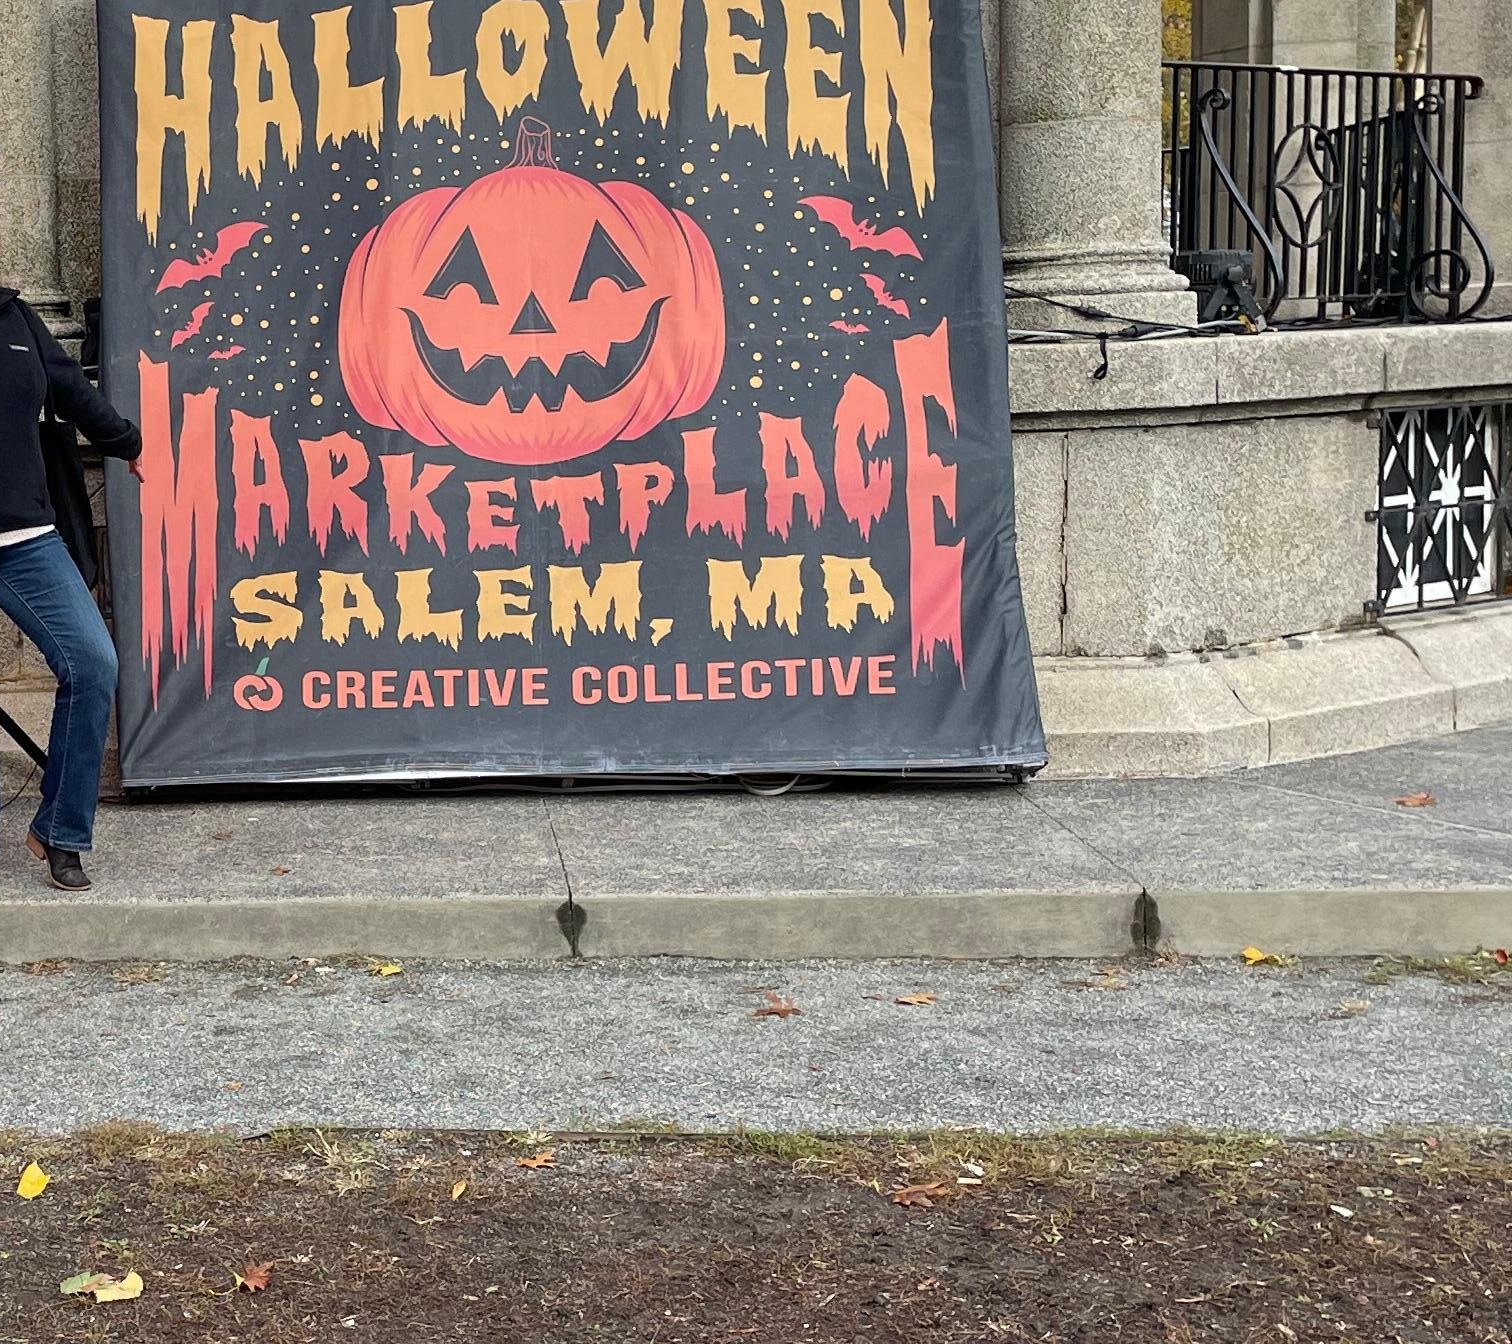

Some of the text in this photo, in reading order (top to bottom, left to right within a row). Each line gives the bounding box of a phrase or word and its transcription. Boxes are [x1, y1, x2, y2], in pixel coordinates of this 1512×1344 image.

[136, 318, 966, 711] MARKETPLACE
[231, 555, 894, 652] SALEM, MA
[302, 655, 896, 709] CREATIVE COLLECTIVE
